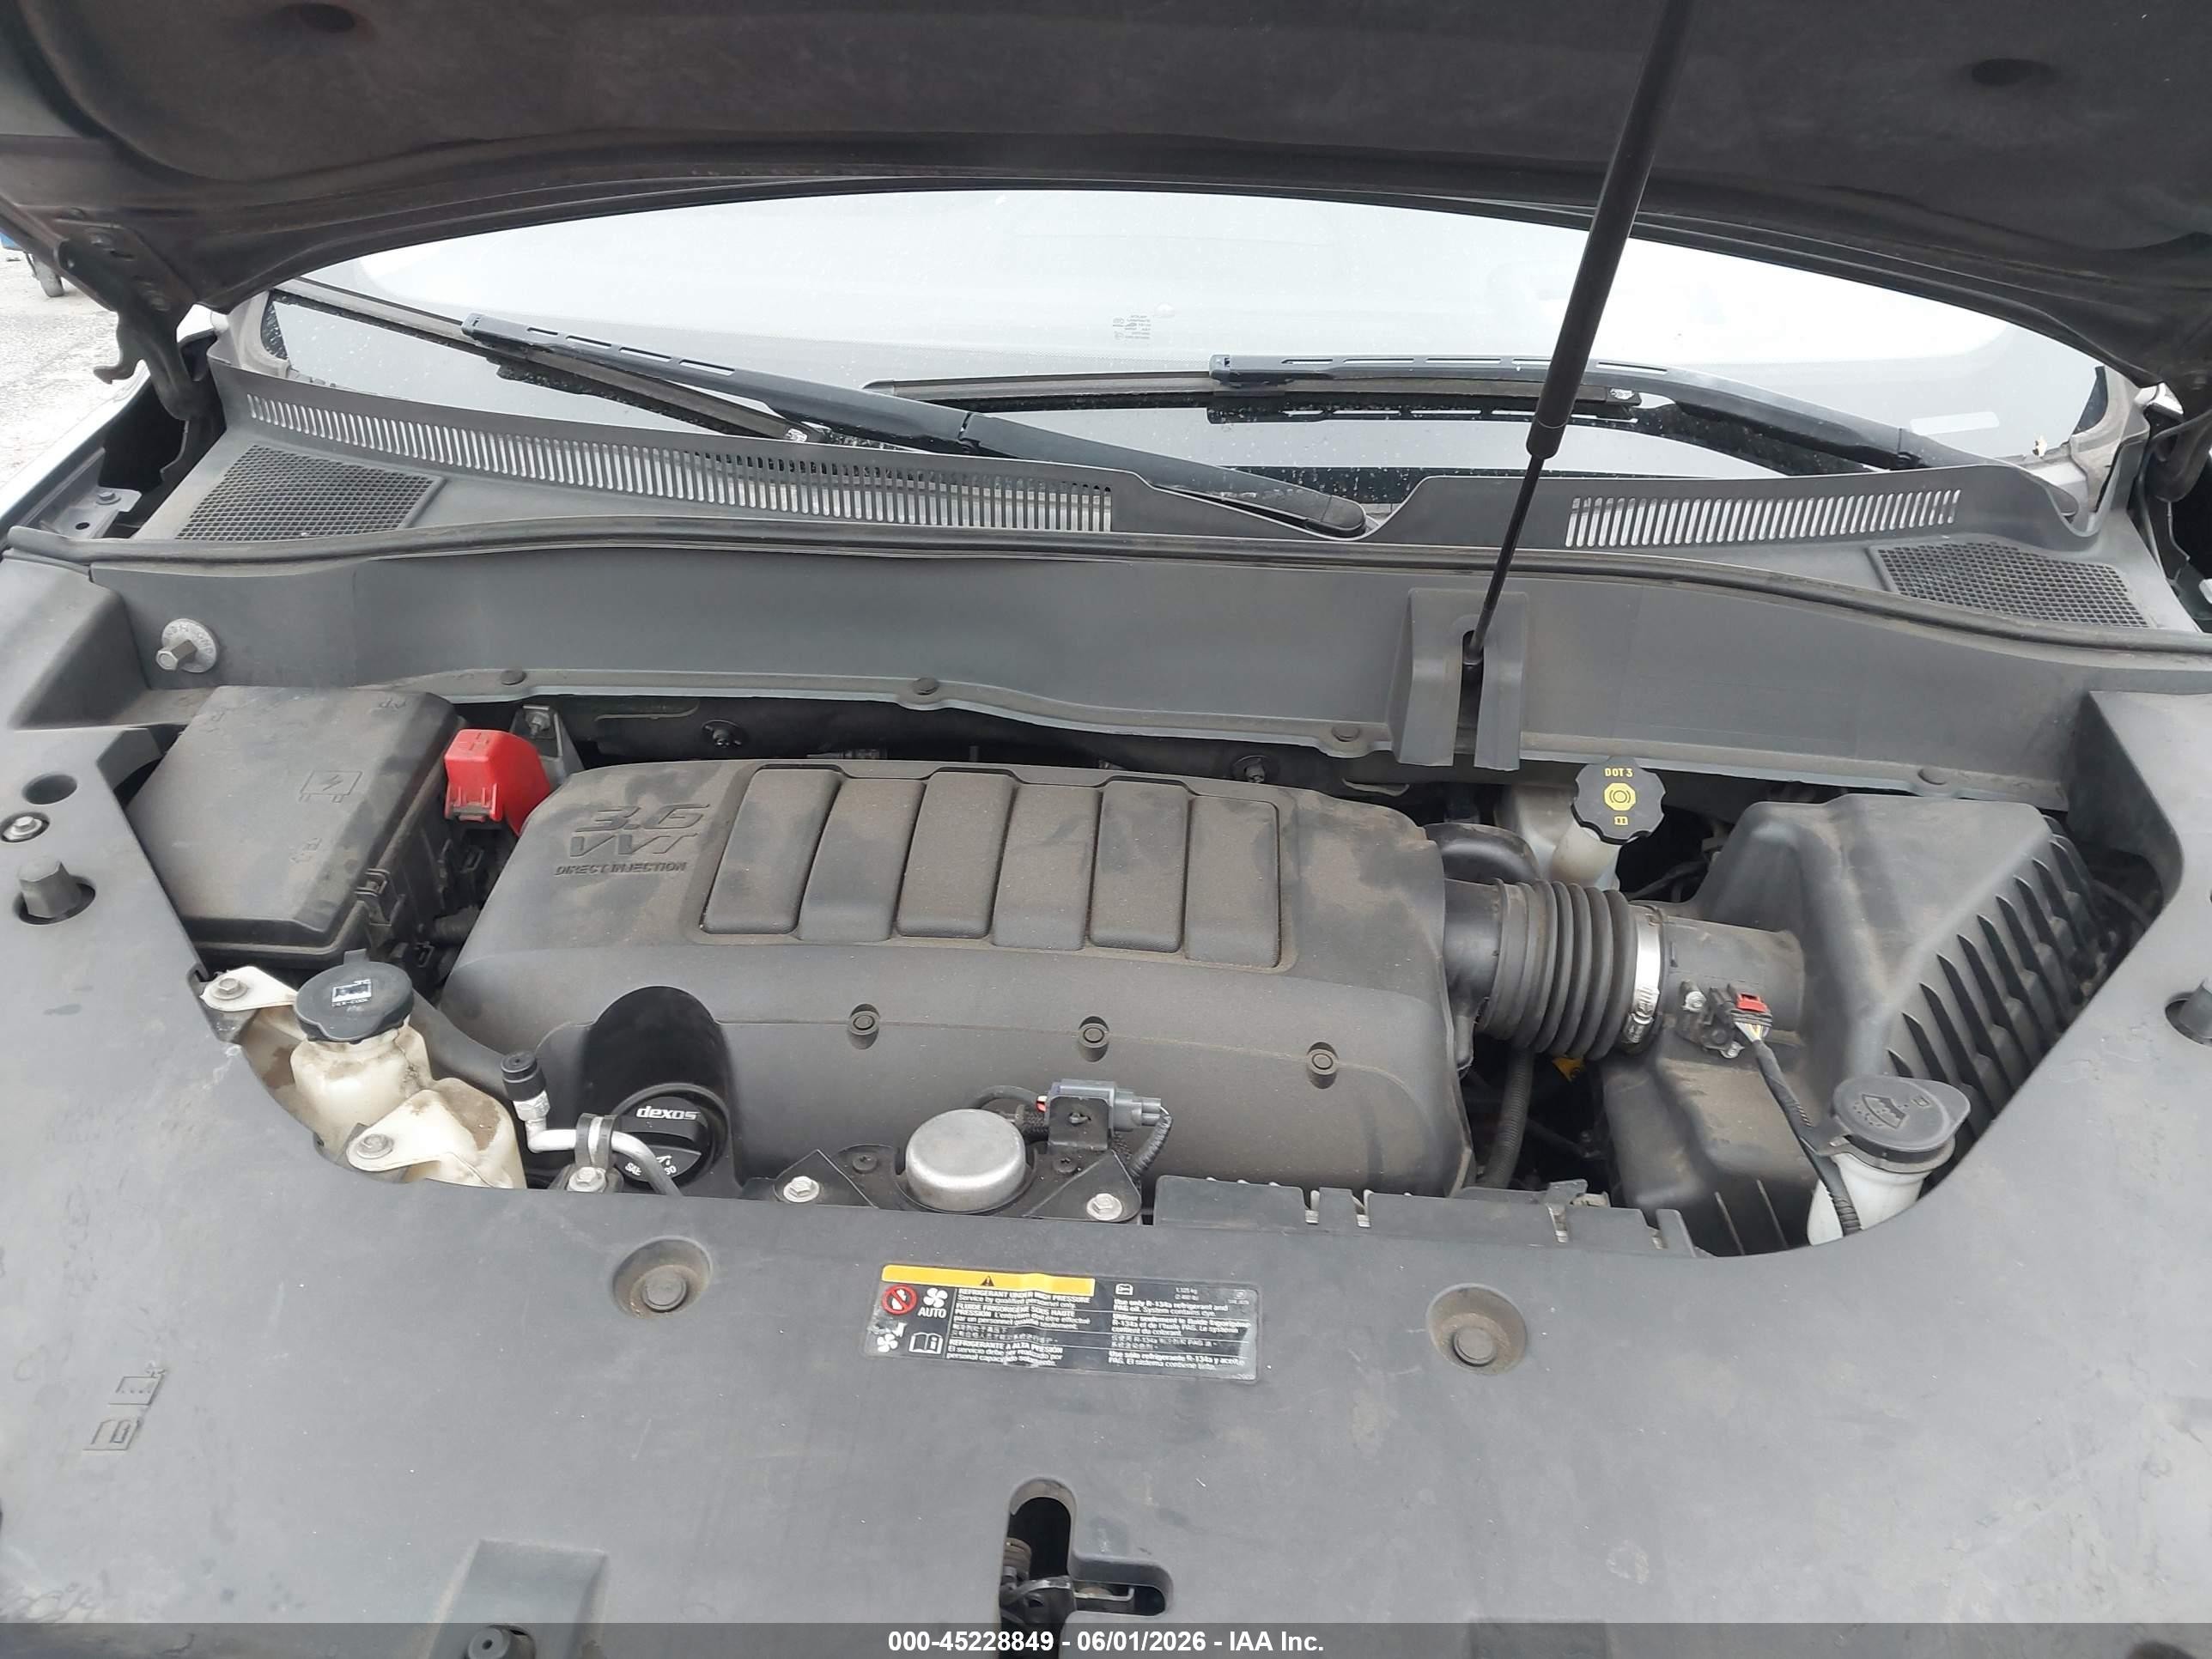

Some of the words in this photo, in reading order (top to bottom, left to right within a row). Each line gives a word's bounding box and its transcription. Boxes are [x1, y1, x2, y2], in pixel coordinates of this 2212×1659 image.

[1604, 768, 1624, 777] DOT
[1626, 768, 1633, 778] 3
[574, 803, 711, 833] 3.6
[569, 833, 700, 858] VVT
[555, 864, 609, 876] DIRECT
[611, 861, 687, 873] INJECTION
[636, 1106, 701, 1120] dexos
[958, 1288, 1009, 1298] REFRIGERANT
[917, 1307, 947, 1319] AUTO
[1012, 1341, 1030, 1350] ALTA
